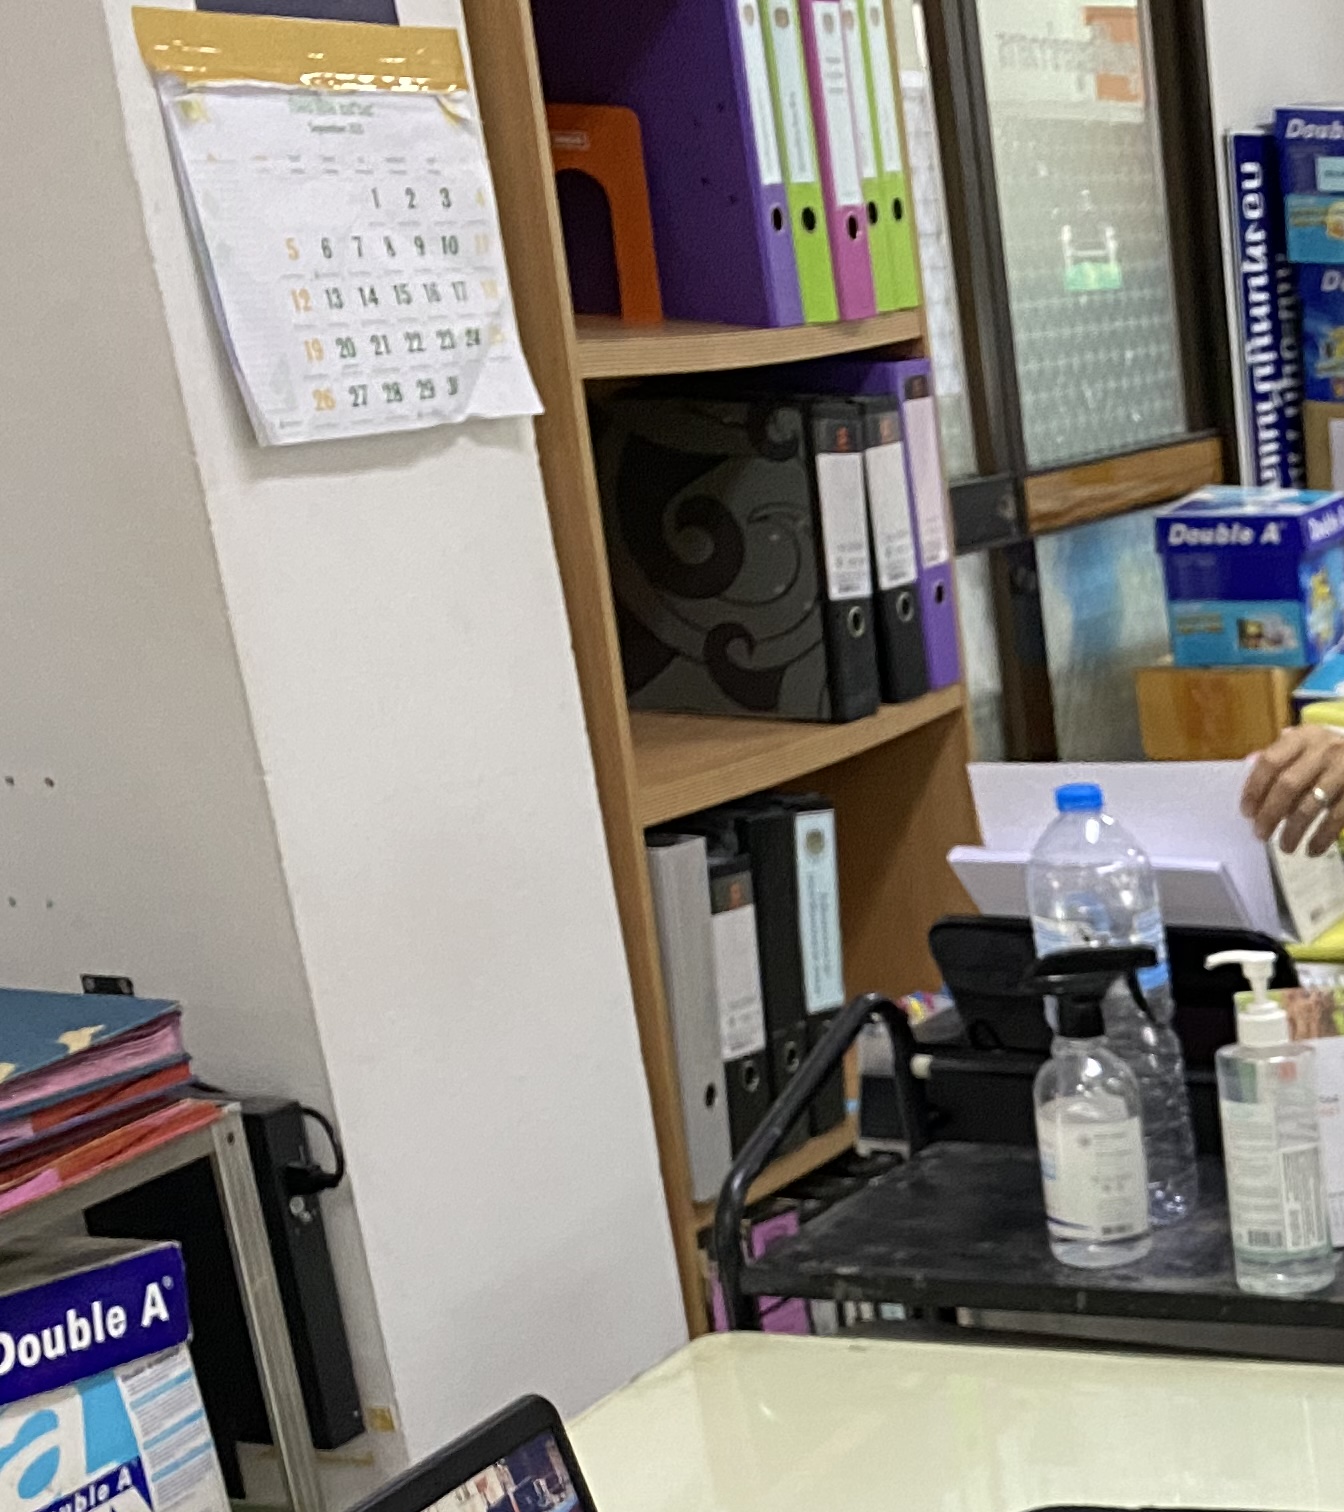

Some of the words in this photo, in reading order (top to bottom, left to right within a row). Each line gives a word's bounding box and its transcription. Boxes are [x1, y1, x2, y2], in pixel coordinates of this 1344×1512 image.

[371, 187, 381, 209] 1
[405, 187, 416, 209] 2
[439, 187, 452, 209] 3
[286, 237, 299, 261] 5
[321, 236, 333, 259] 6
[351, 235, 363, 258] 7
[414, 235, 426, 256] 9
[441, 234, 459, 256] 10
[291, 287, 313, 314] 12
[325, 286, 344, 310] 13
[358, 285, 379, 307] 14
[393, 283, 412, 305] 15
[451, 280, 469, 302] 17
[304, 338, 324, 364] 19
[336, 336, 357, 359] 20
[370, 334, 392, 355] 21
[404, 331, 427, 352] 22
[348, 383, 368, 407] 27
[1167, 523, 1254, 546] Double
[1259, 523, 1283, 545] A
[0, 1300, 128, 1377] Double
[140, 1282, 170, 1328] A
[116, 1465, 133, 1492] A
